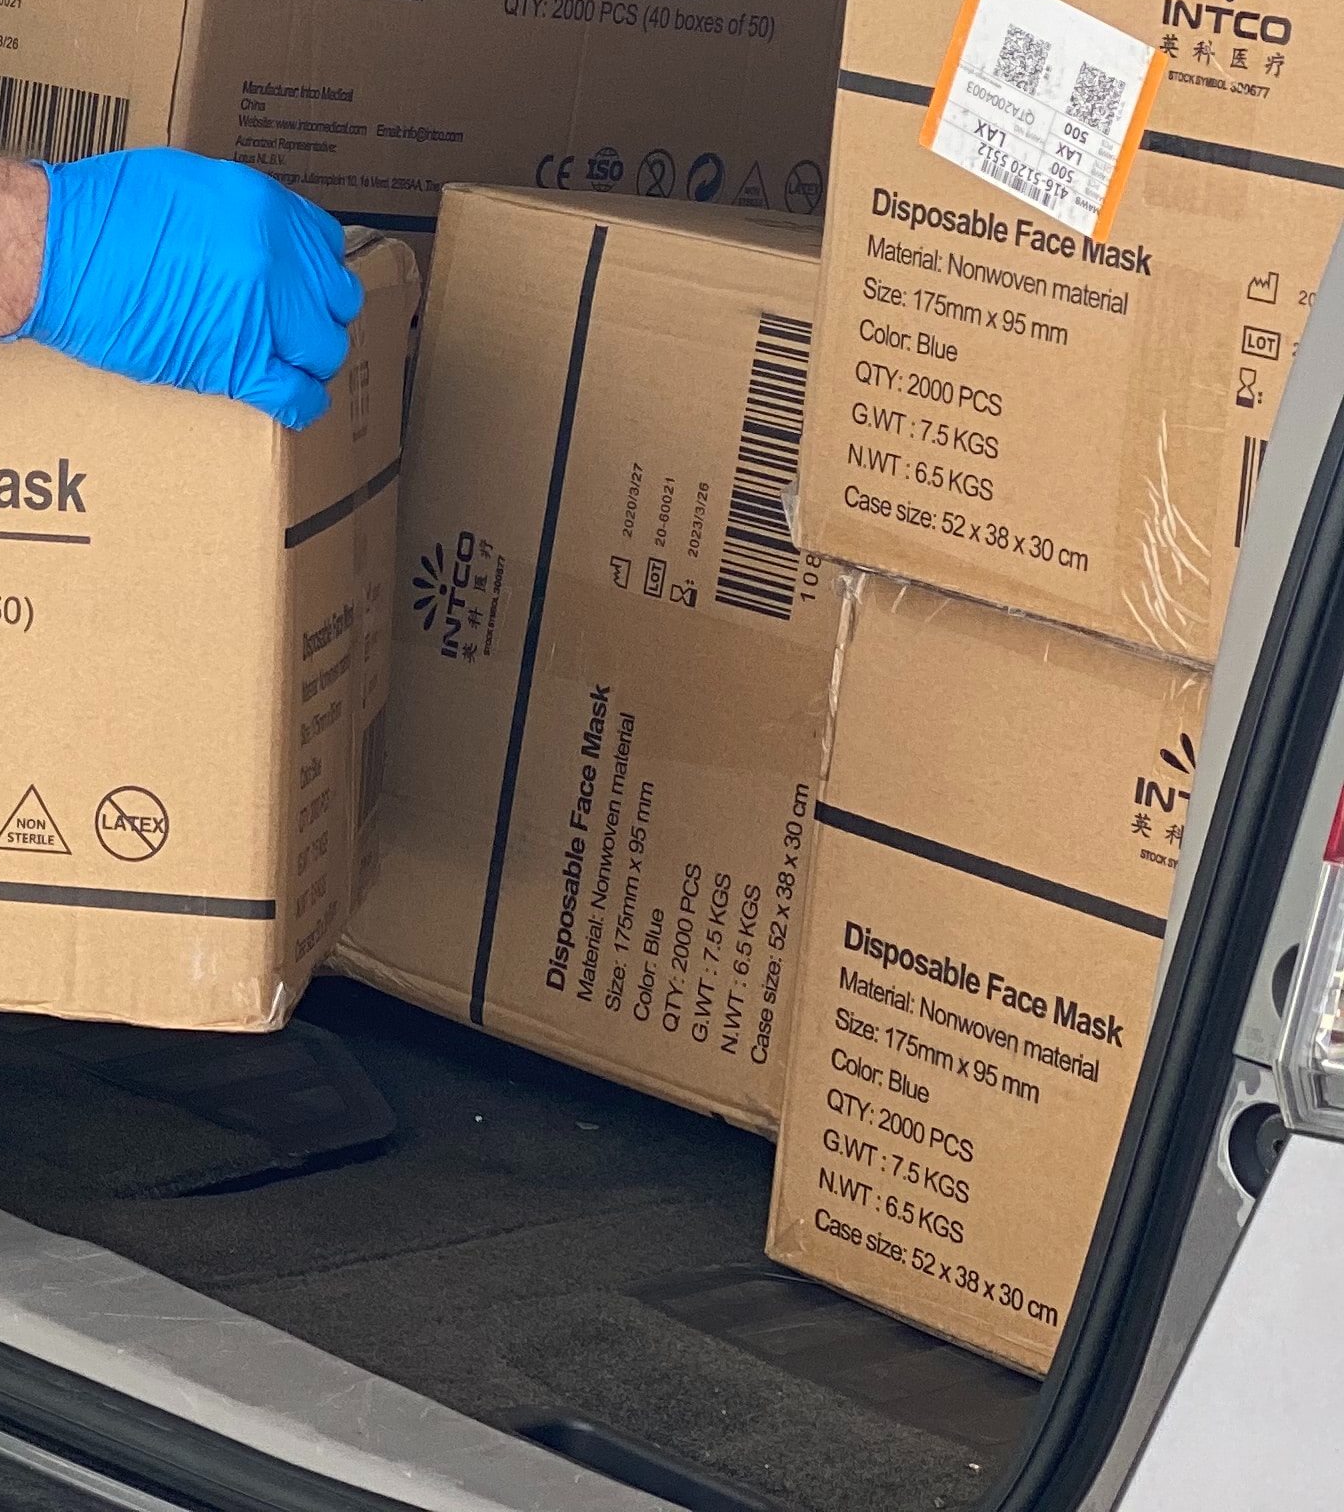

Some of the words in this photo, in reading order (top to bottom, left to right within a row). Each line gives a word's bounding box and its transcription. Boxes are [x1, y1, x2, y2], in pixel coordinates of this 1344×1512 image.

[598, 0, 639, 26] PCS
[642, 4, 671, 33] (40
[673, 7, 724, 34] boxes
[727, 12, 747, 36] of
[747, 14, 775, 44] 50)
[1158, 33, 1285, 78] 英科医疗
[973, 118, 1007, 149] LAX
[1055, 141, 1083, 165] LAX
[1063, 122, 1090, 145] 500
[1050, 161, 1074, 184] 500
[871, 187, 1008, 243] Disposable
[1014, 218, 1076, 258] Face
[1081, 234, 1152, 276] Mask
[866, 233, 943, 273] Material:
[946, 251, 1047, 297] Nonwoven
[1051, 281, 1129, 315] material
[858, 318, 912, 351] Color:
[916, 331, 958, 362] Blue
[862, 275, 907, 307] Size:
[913, 288, 982, 326] 175mm
[985, 310, 998, 329] x
[1001, 309, 1027, 335] 95
[1030, 320, 1068, 346] mm
[1247, 332, 1276, 353] LOT
[854, 359, 903, 392] QTY:
[906, 372, 954, 404] 2000
[958, 384, 1002, 417] PCS
[622, 461, 645, 539] 2020/3/27
[653, 475, 676, 549] 20-60021
[687, 481, 711, 559] 2023/3/26
[440, 530, 476, 659] INTCO
[648, 562, 664, 593] LOT
[580, 683, 610, 759] Mask
[610, 711, 635, 795] material
[16, 817, 46, 830] NON
[100, 812, 165, 836] LATEX
[568, 764, 597, 832] Face
[6, 831, 55, 846] STERILE
[589, 799, 622, 910] Nonwoven
[545, 836, 585, 992] Disposable
[679, 862, 702, 914] PCS
[576, 914, 604, 1002] Material:
[642, 907, 664, 956] Blue
[670, 917, 694, 974] 2000
[633, 960, 657, 1022] Color:
[662, 975, 685, 1032] QTY:
[843, 920, 981, 995] Disposable
[985, 971, 1048, 1019] Face
[1052, 995, 1124, 1048] Mask
[834, 1006, 879, 1043] Size:
[884, 1026, 954, 1072] 175mm
[955, 1057, 970, 1078] x
[972, 1059, 998, 1087] 95
[1001, 1074, 1040, 1104] mm
[839, 965, 915, 1014] Material:
[919, 995, 1019, 1053] Nonwoven
[1022, 1039, 1100, 1083] material
[830, 1047, 884, 1087] Color:
[887, 1068, 930, 1104] Blue
[826, 1087, 874, 1125] QTY:
[877, 1107, 925, 1144] 2000
[929, 1126, 974, 1163] PCS
[814, 1207, 862, 1246] Case
[865, 1231, 907, 1265] size:
[910, 1246, 936, 1276] 52
[938, 1262, 952, 1283] x
[954, 1264, 980, 1293] 38
[982, 1280, 995, 1301] x
[998, 1282, 1024, 1311] 30
[1026, 1299, 1058, 1327] cm
